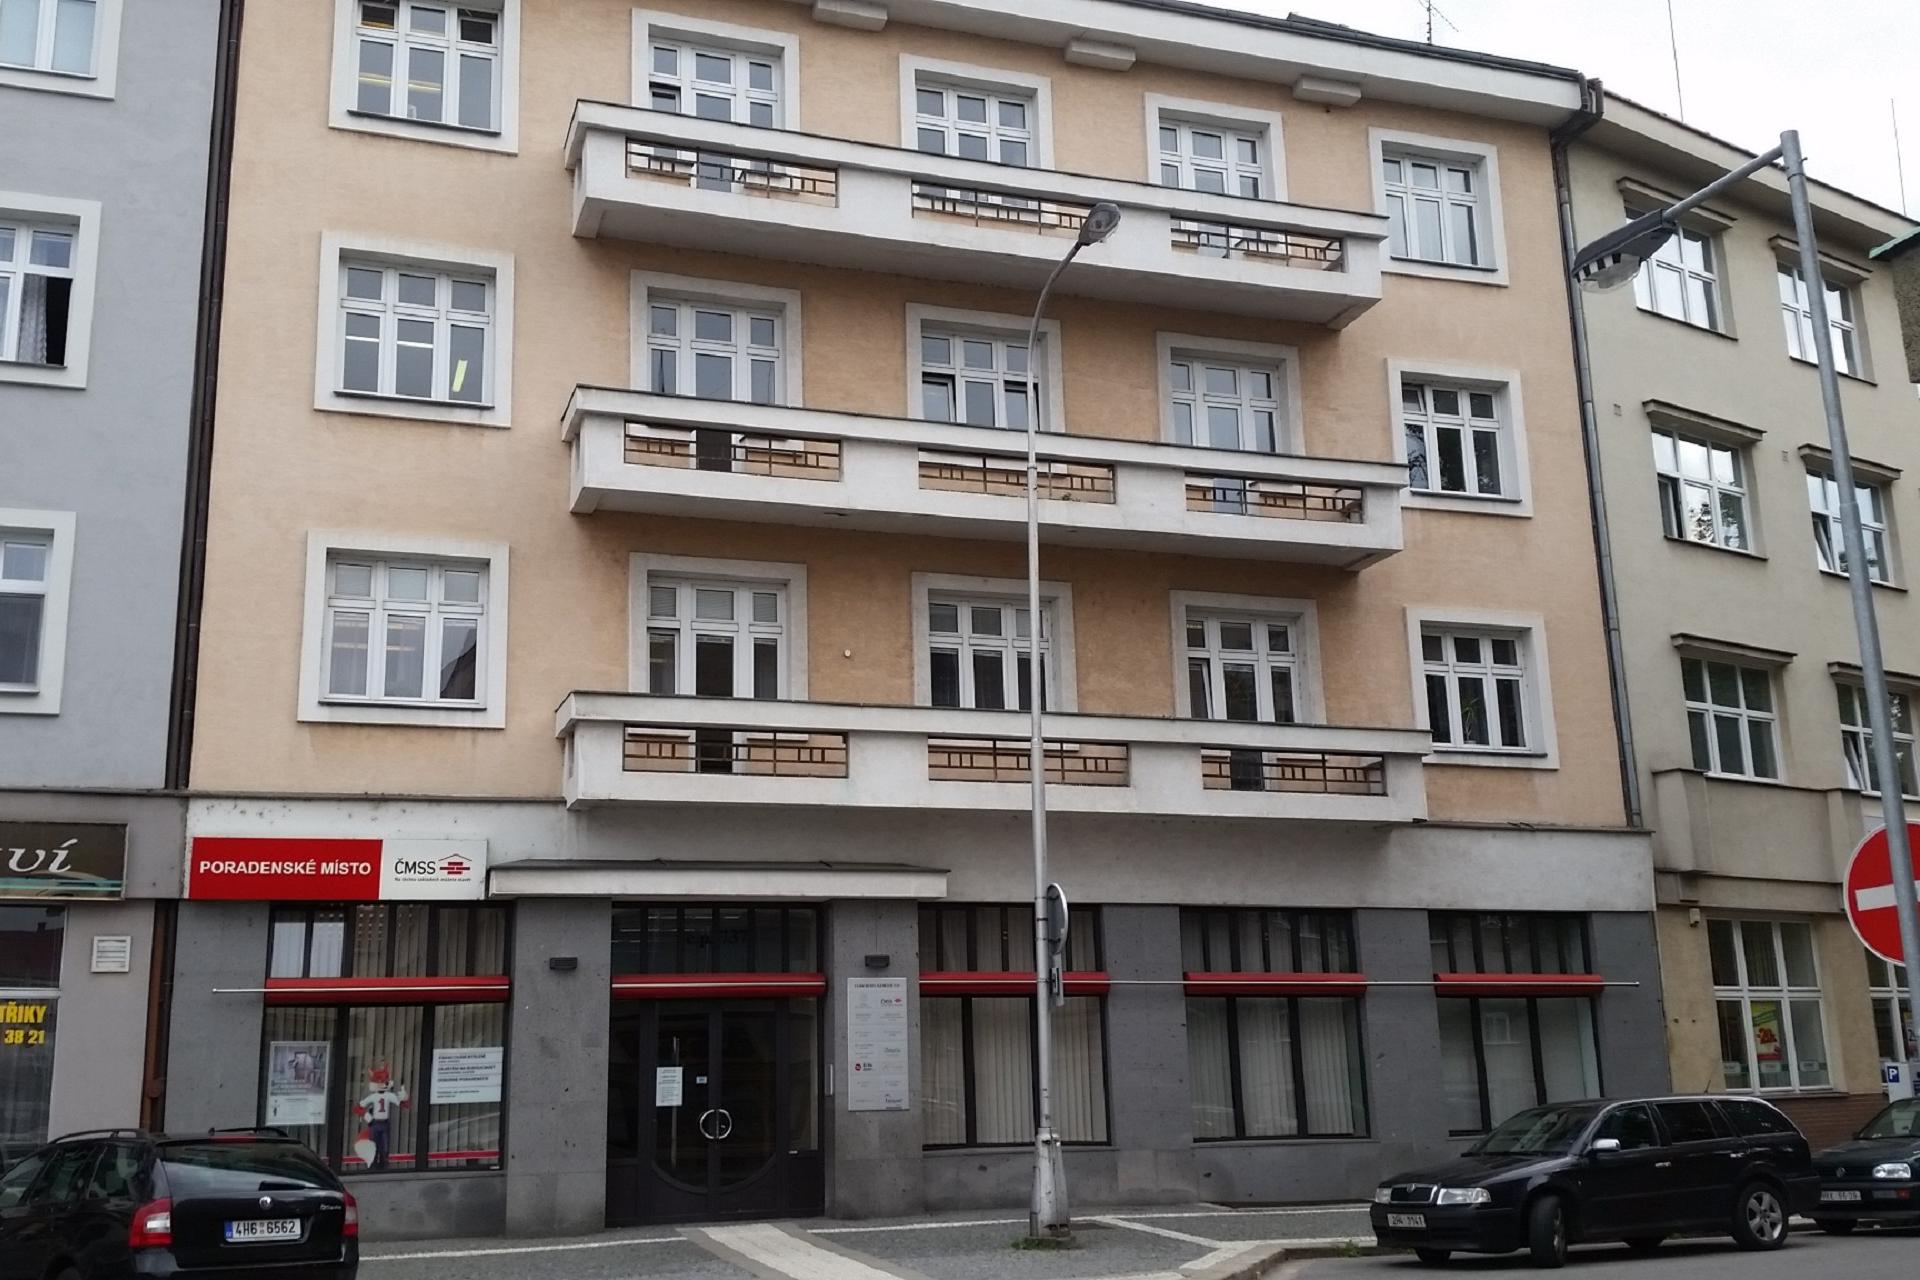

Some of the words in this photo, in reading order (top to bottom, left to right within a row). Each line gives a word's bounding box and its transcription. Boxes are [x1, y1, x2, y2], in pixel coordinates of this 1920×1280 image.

[0, 838, 78, 873] ví
[199, 859, 317, 875] PORADENSKÉ
[320, 859, 372, 876] MÍSTO
[394, 857, 436, 875] ČMSS
[4, 1029, 24, 1045] 38
[28, 1029, 45, 1045] 21
[1889, 1068, 1898, 1080] P
[235, 1222, 258, 1236] 4H6
[266, 1220, 296, 1234] 6562
